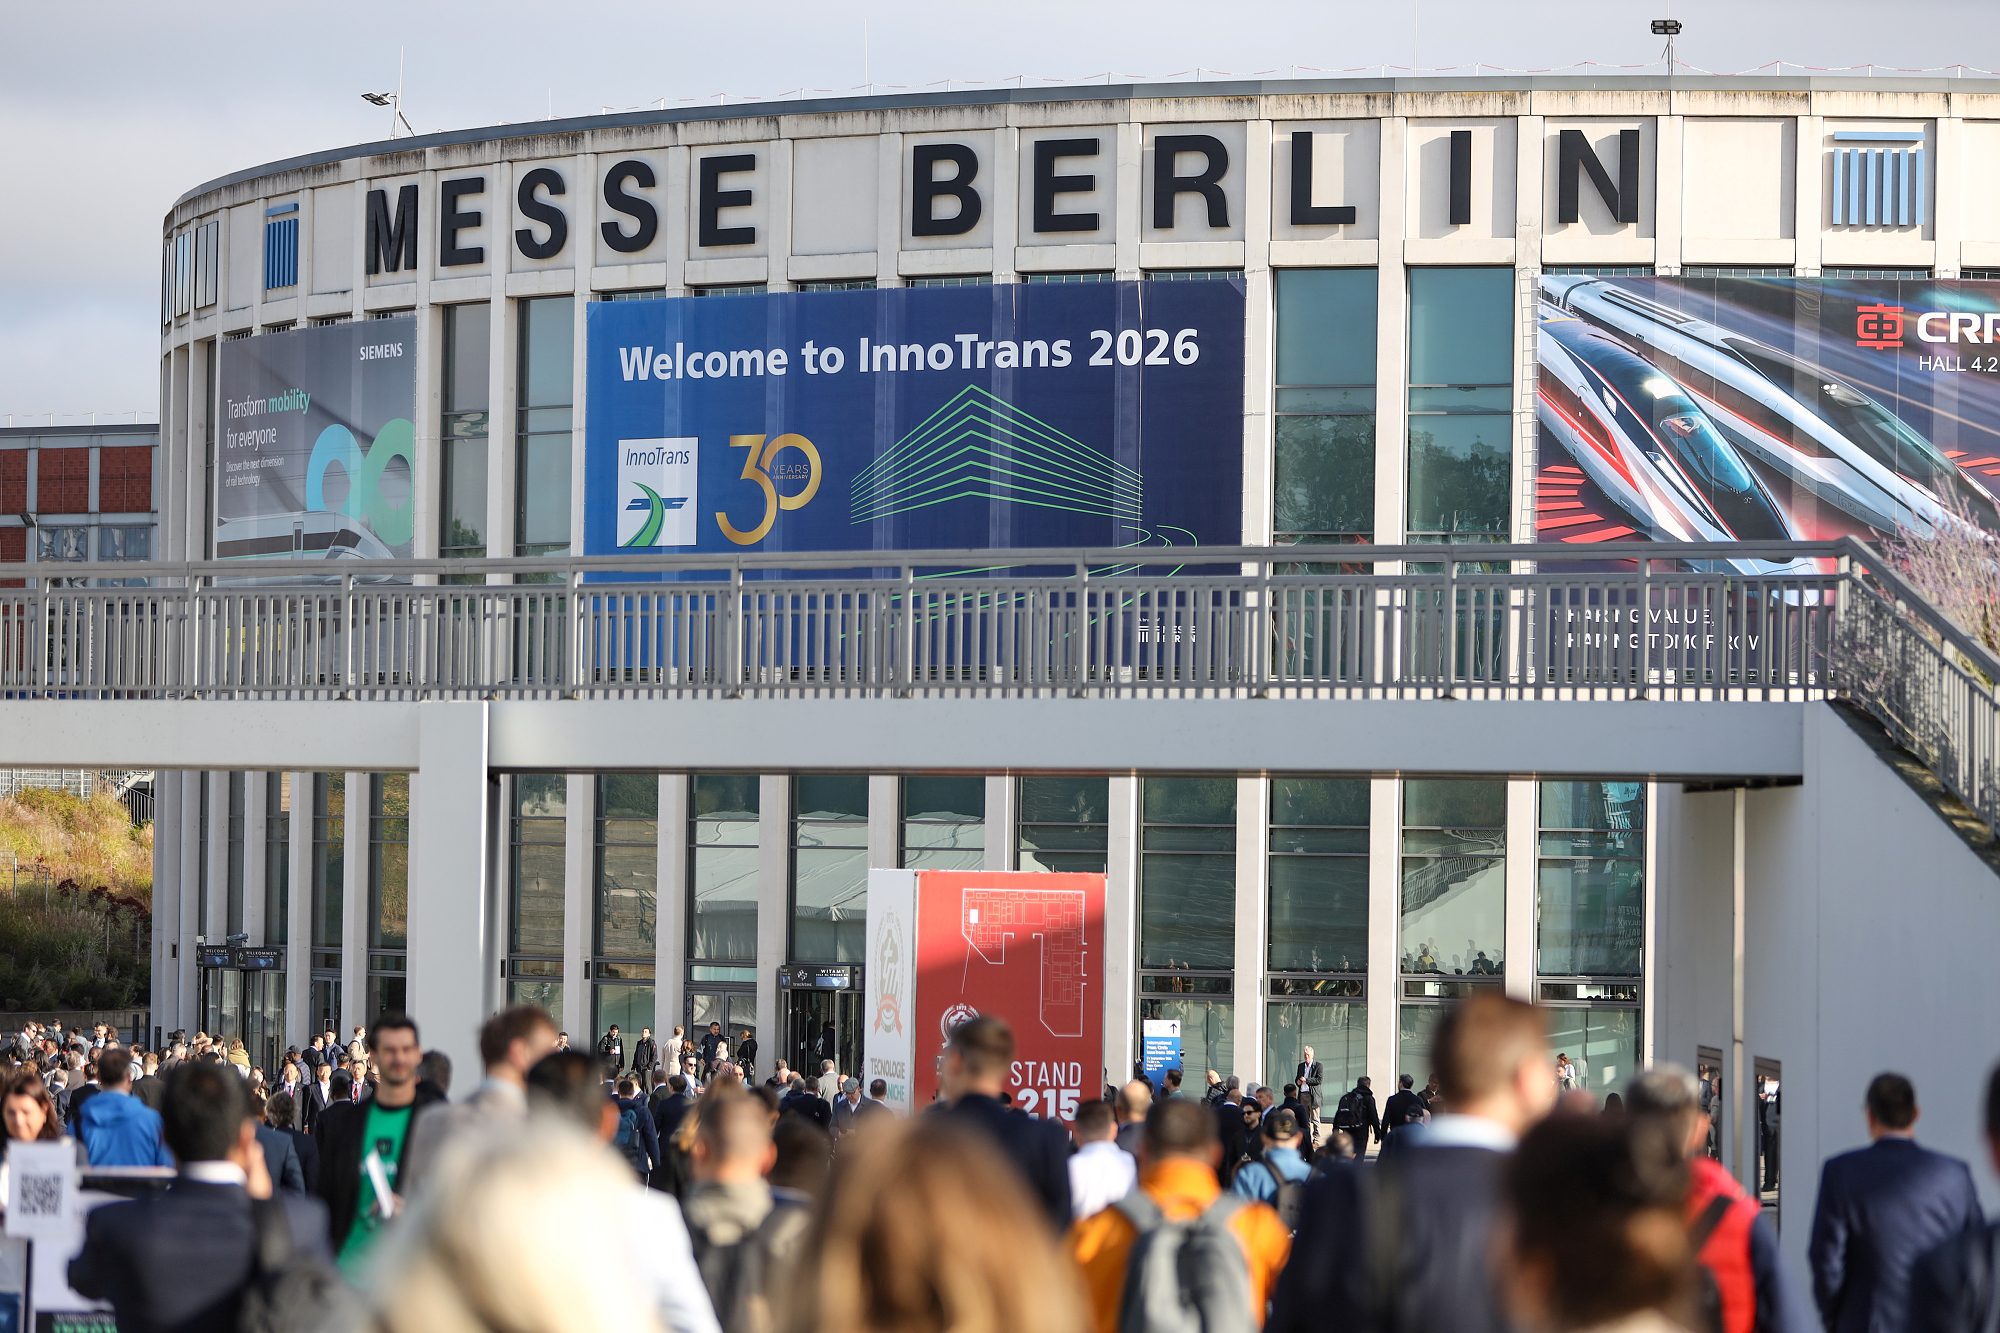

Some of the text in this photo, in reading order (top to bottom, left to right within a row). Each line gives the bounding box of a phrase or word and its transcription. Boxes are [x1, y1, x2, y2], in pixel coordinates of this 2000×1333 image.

[366, 130, 1639, 275] MESSE BERLIN
[360, 342, 403, 361] SIEMENS
[619, 328, 1200, 382] Welcome to InnoTrans 2026
[1919, 356, 1998, 372] HALL 4.2
[227, 388, 311, 420] Transform mobility
[227, 427, 277, 452] for everyone
[226, 455, 285, 472] Discover the next dimension
[626, 445, 690, 467] InnoTrans
[226, 476, 231, 487] of
[238, 474, 261, 487] technology
[773, 465, 809, 474] YEARS
[715, 433, 822, 545] 30
[1649, 608, 1715, 627] VALUE,
[870, 1057, 905, 1080] TECNOLOGIE
[1010, 1061, 1082, 1087] STAND
[1017, 1088, 1081, 1121] 215
